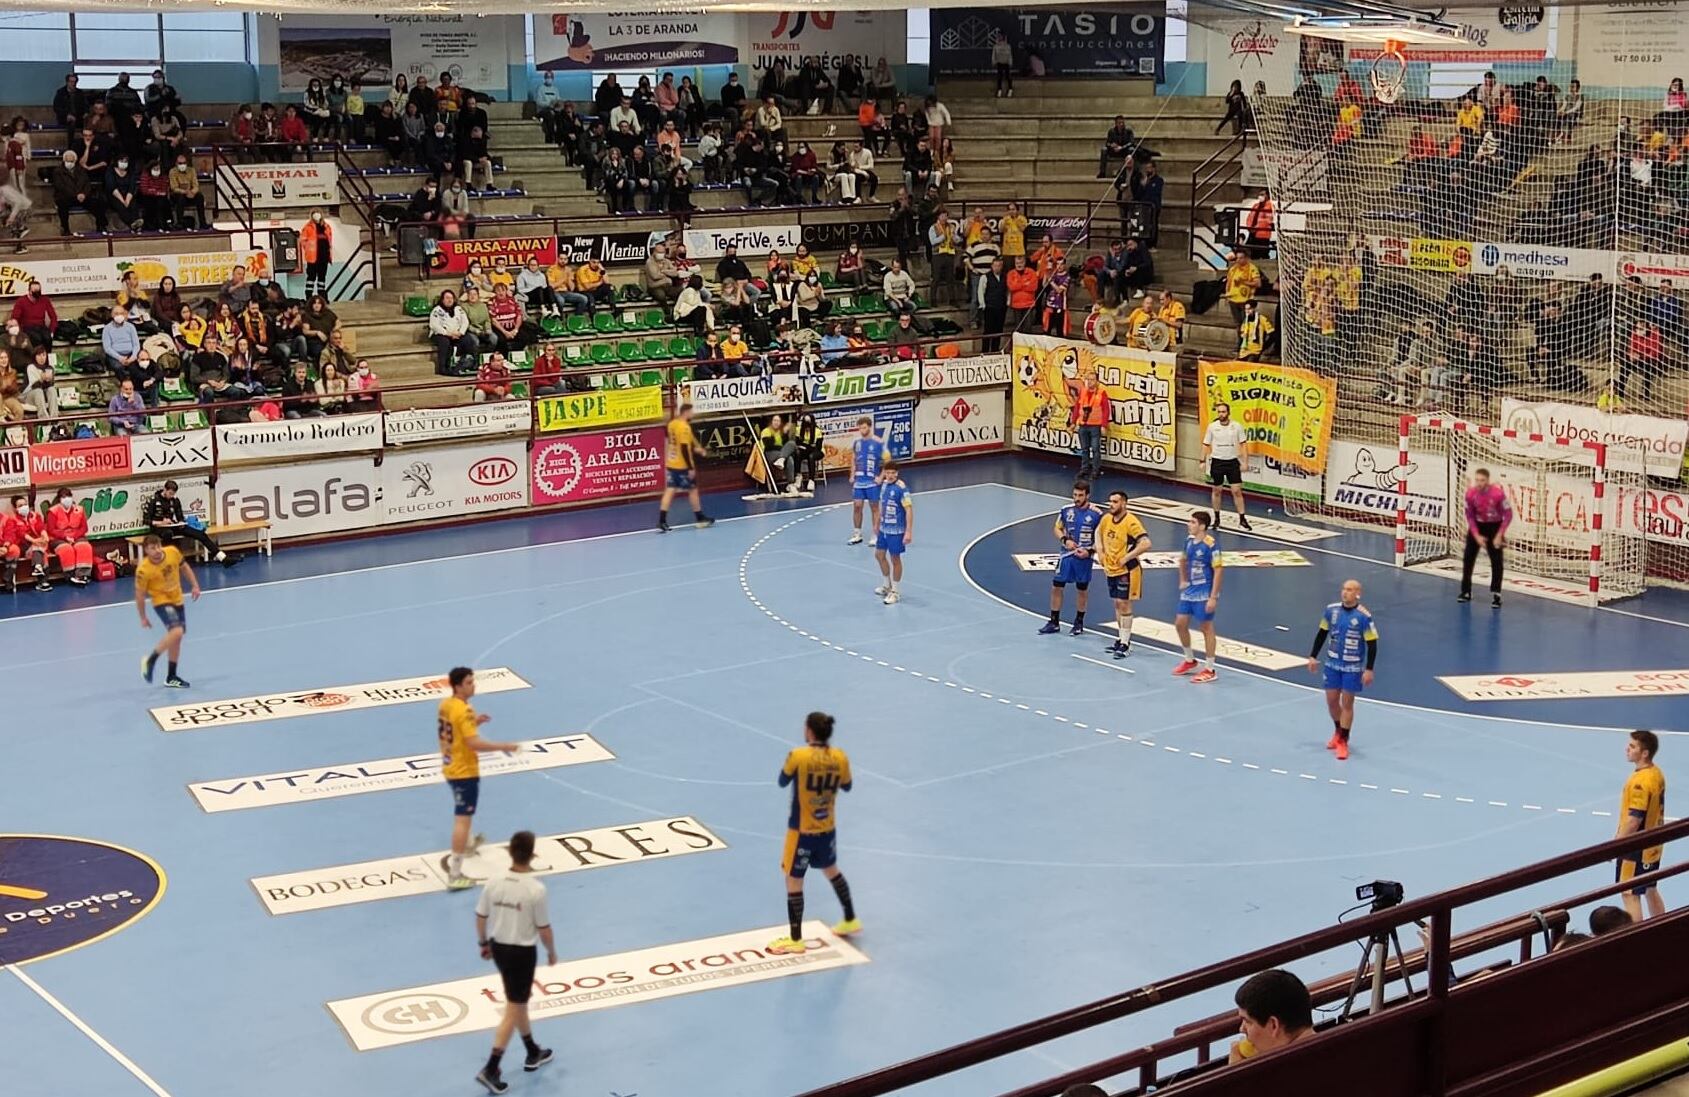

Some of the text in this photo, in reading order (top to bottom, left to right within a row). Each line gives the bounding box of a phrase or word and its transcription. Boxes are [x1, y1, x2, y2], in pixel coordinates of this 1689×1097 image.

[609, 23, 699, 36] LA 3 DE ARANDA
[1018, 14, 1155, 35] TASIO
[1503, 14, 1538, 25] Galicia
[752, 43, 800, 51] TRANSPORTES
[1018, 39, 1154, 48] construcciones
[239, 169, 319, 179] WEIMAR
[454, 239, 550, 254] BRASA-AWAY
[574, 237, 594, 247] New
[776, 230, 798, 247] s.l.
[562, 236, 645, 263] Prad Marina
[1504, 251, 1569, 267] medhesa
[947, 365, 1009, 384] TUDANCA
[1098, 364, 1169, 398] LA PEÑA
[543, 395, 607, 428] JASPE
[955, 403, 967, 420] T
[1110, 399, 1171, 425] TATA
[223, 425, 304, 445] Carmelo
[311, 421, 375, 440] Rodero
[388, 414, 488, 433] MONTOUTO
[604, 433, 641, 449] BICI
[920, 425, 999, 447] TUDANCA
[1019, 423, 1082, 450] ARANDA
[1109, 437, 1167, 464] DUERO
[1550, 417, 1683, 455] tubos aranda
[33, 449, 122, 473] Microsshop
[138, 446, 209, 468] AJAX
[585, 447, 660, 468] ARANDA
[477, 463, 511, 480] KIA
[541, 467, 576, 477] ARANDA
[388, 499, 453, 515] PEUGEOT
[464, 490, 522, 505] KIA MOTORS
[1334, 488, 1443, 519] MICHLIN
[1615, 487, 1689, 537] res
[92, 519, 147, 532] en bacala
[363, 686, 421, 699] Hiro
[371, 690, 442, 701] shima
[170, 705, 273, 725] sport
[177, 698, 287, 718] prado
[805, 772, 841, 796] 44
[440, 820, 713, 881] CRES
[265, 867, 428, 901] BODEGAS
[4, 890, 133, 922] Deportes
[38, 898, 142, 924] Duero
[481, 970, 634, 1003] tbos
[530, 955, 816, 1010] ABRICACIÓN DE TUBOS Y PERFILES
